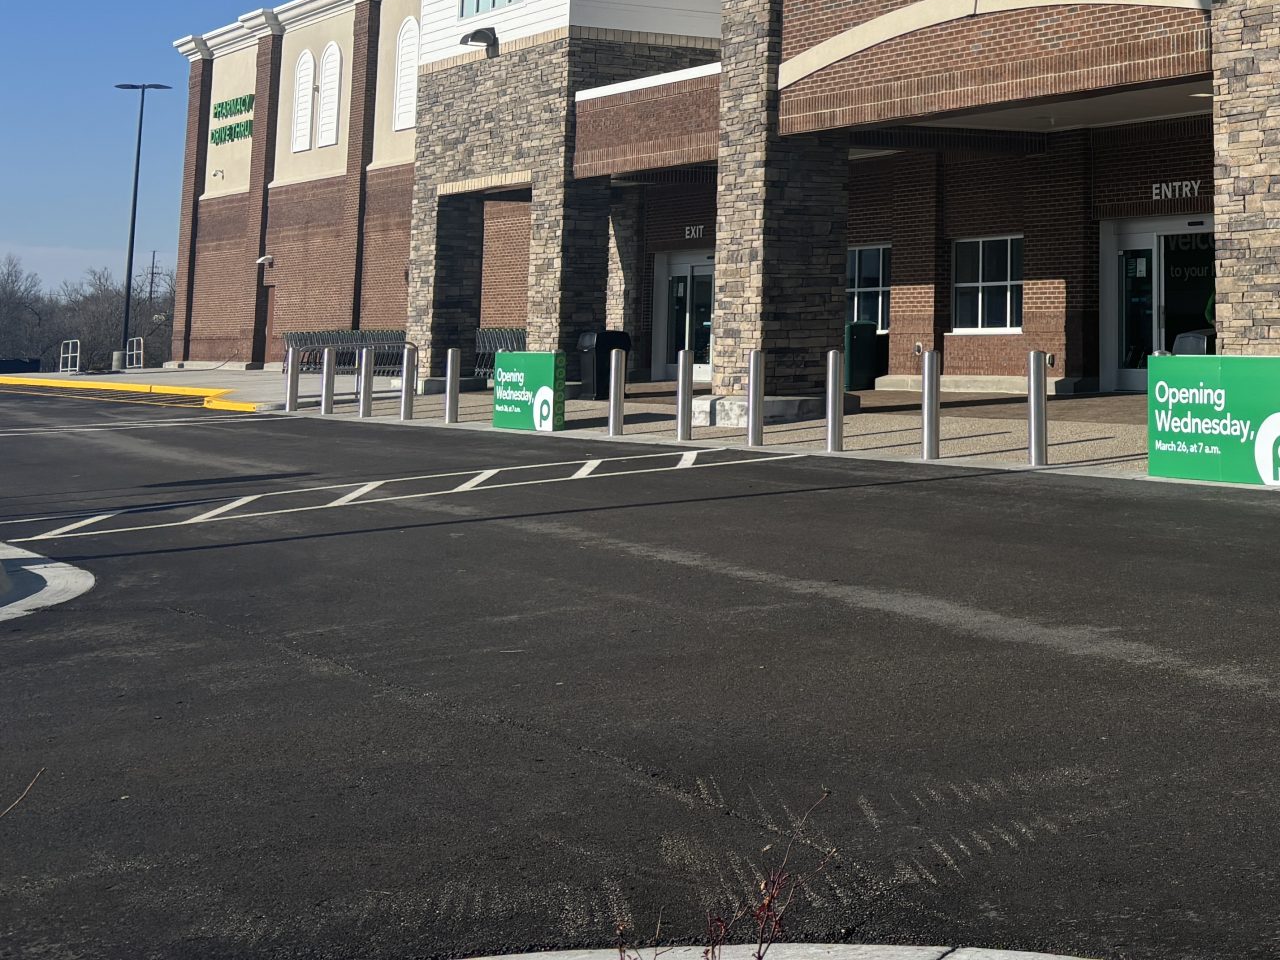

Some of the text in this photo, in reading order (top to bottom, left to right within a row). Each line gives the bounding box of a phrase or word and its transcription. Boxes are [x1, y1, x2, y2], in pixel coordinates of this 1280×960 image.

[213, 93, 254, 119] PHARMACY
[210, 120, 253, 145] DRIVE THRU
[1152, 179, 1202, 200] ENTRY
[685, 225, 705, 239] EXIT
[1170, 263, 1182, 277] to
[1184, 265, 1209, 281] your
[497, 367, 524, 386] Opening
[496, 385, 535, 405] Wednesday,
[1155, 380, 1226, 411] Opening
[1155, 409, 1255, 443] Wednesday,
[1155, 439, 1221, 454] March 26, at 7 a.m.
